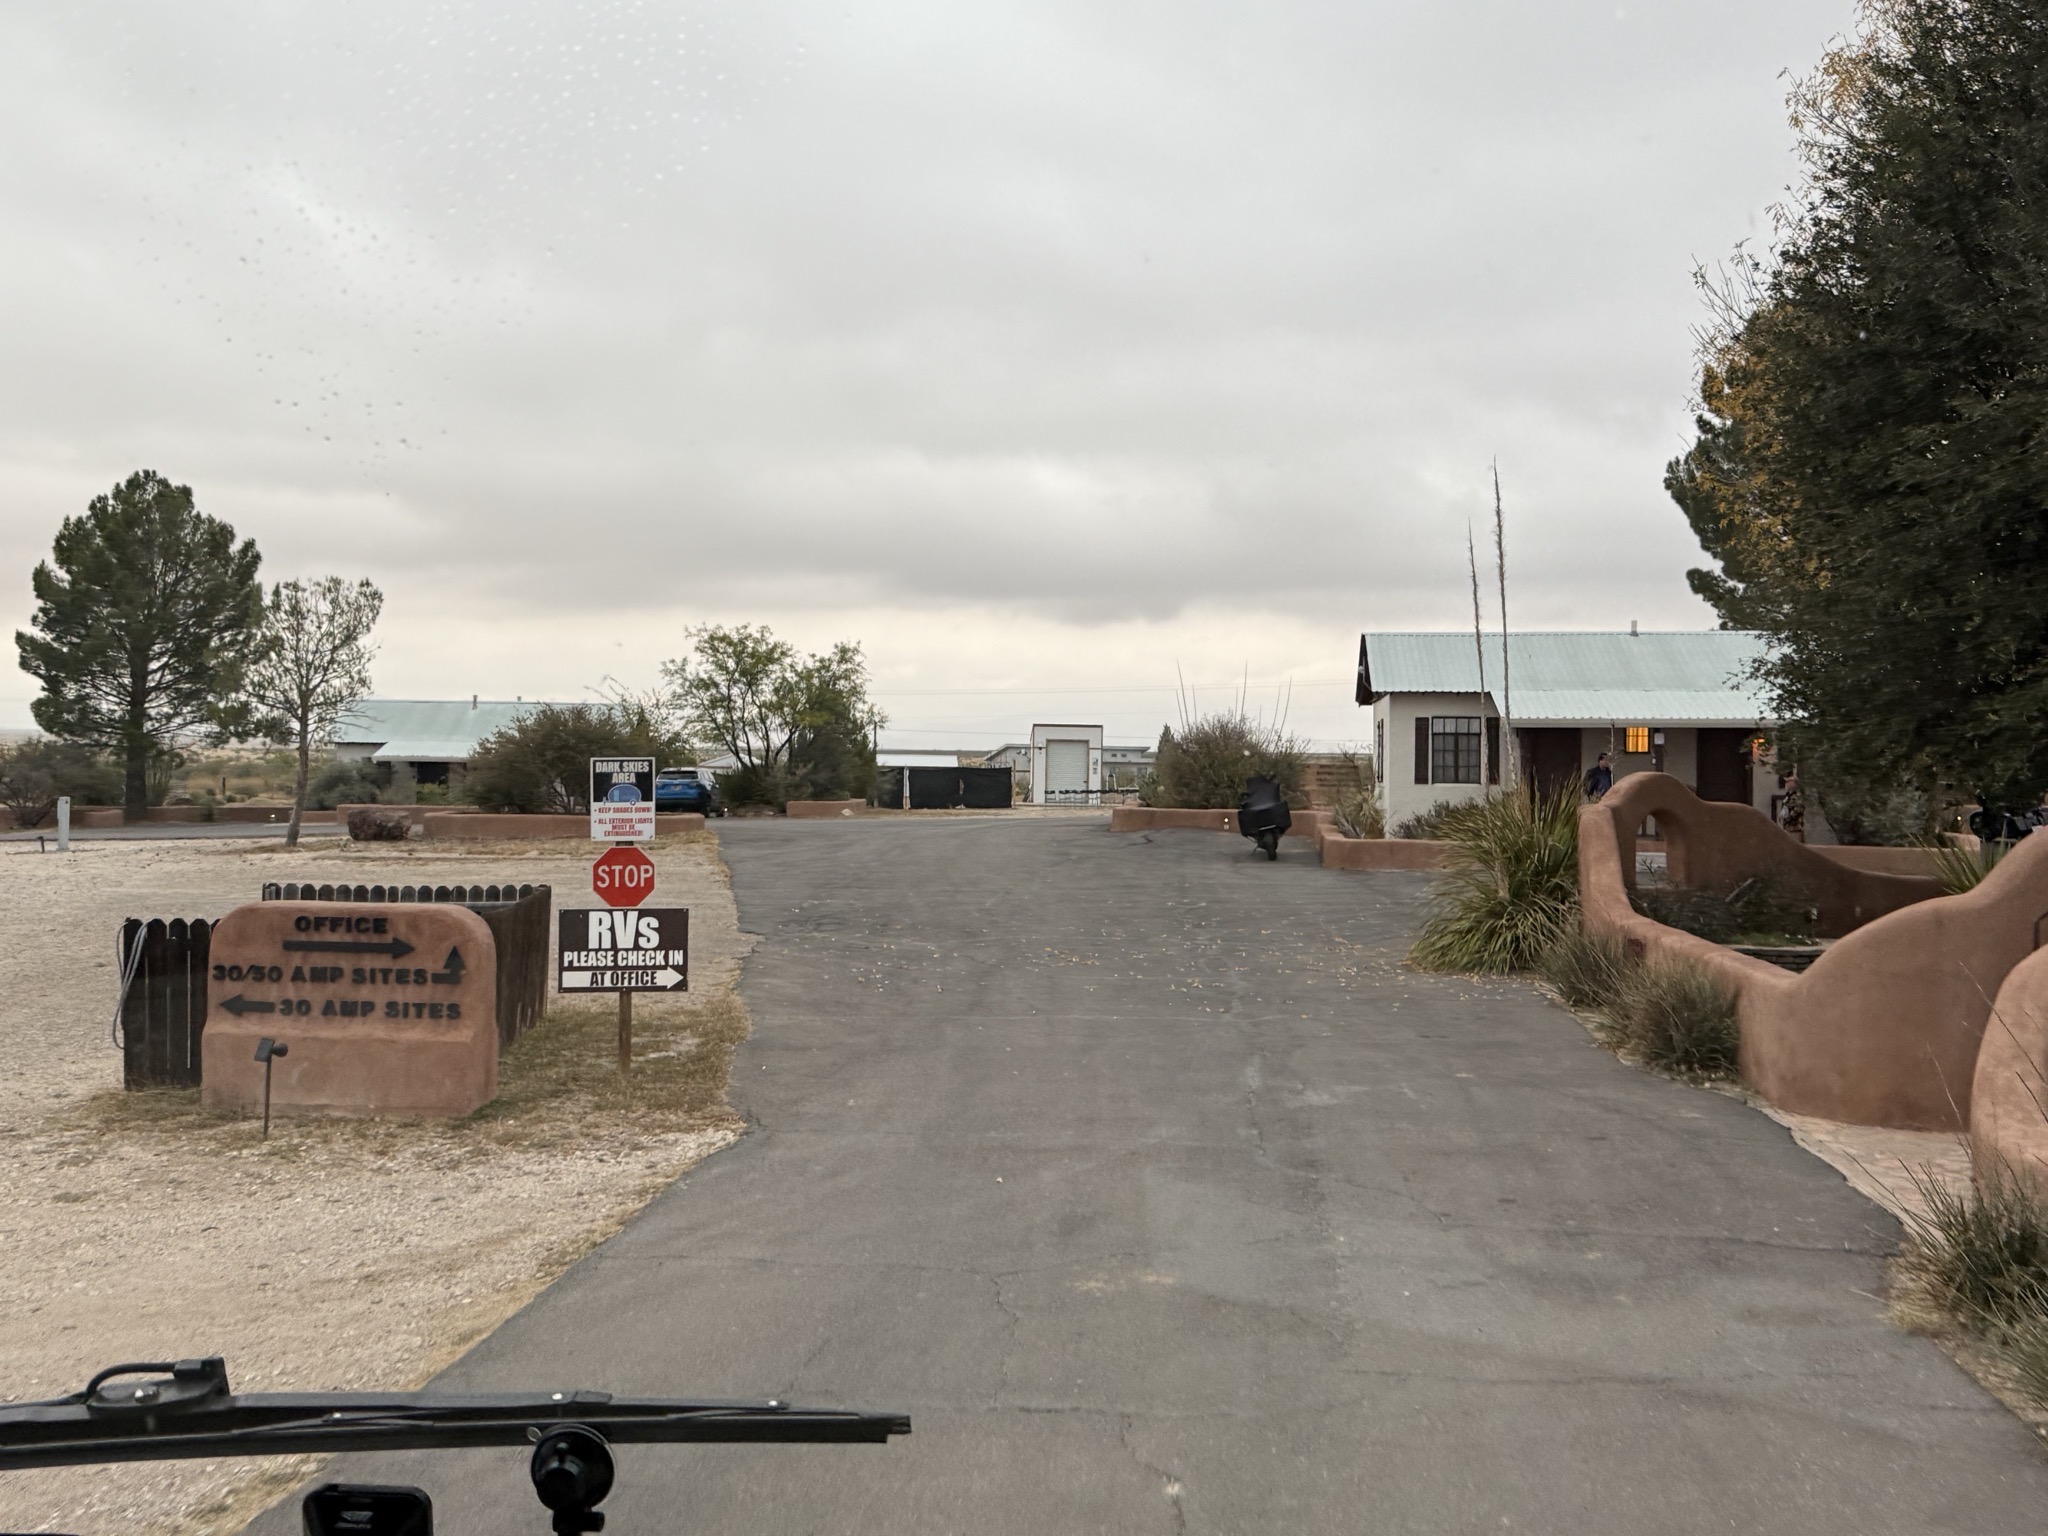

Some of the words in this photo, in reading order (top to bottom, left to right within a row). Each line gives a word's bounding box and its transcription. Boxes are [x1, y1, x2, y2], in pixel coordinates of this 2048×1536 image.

[596, 762, 620, 772] DARK
[622, 761, 650, 772] SKIES
[612, 772, 636, 784] AREA
[597, 864, 653, 888] STOP
[295, 916, 388, 934] OFFICE
[588, 910, 660, 950] RVs
[564, 950, 614, 967] PLEASE
[617, 950, 666, 966] CHECK
[668, 950, 684, 966] IN
[212, 965, 283, 982] 30/50
[290, 966, 344, 983] AMP
[352, 968, 428, 985] SITES
[590, 972, 606, 986] AT
[610, 971, 658, 986] OFFICE
[279, 999, 312, 1016] 30
[321, 1000, 376, 1017] AMP
[385, 1002, 461, 1019] SITES
